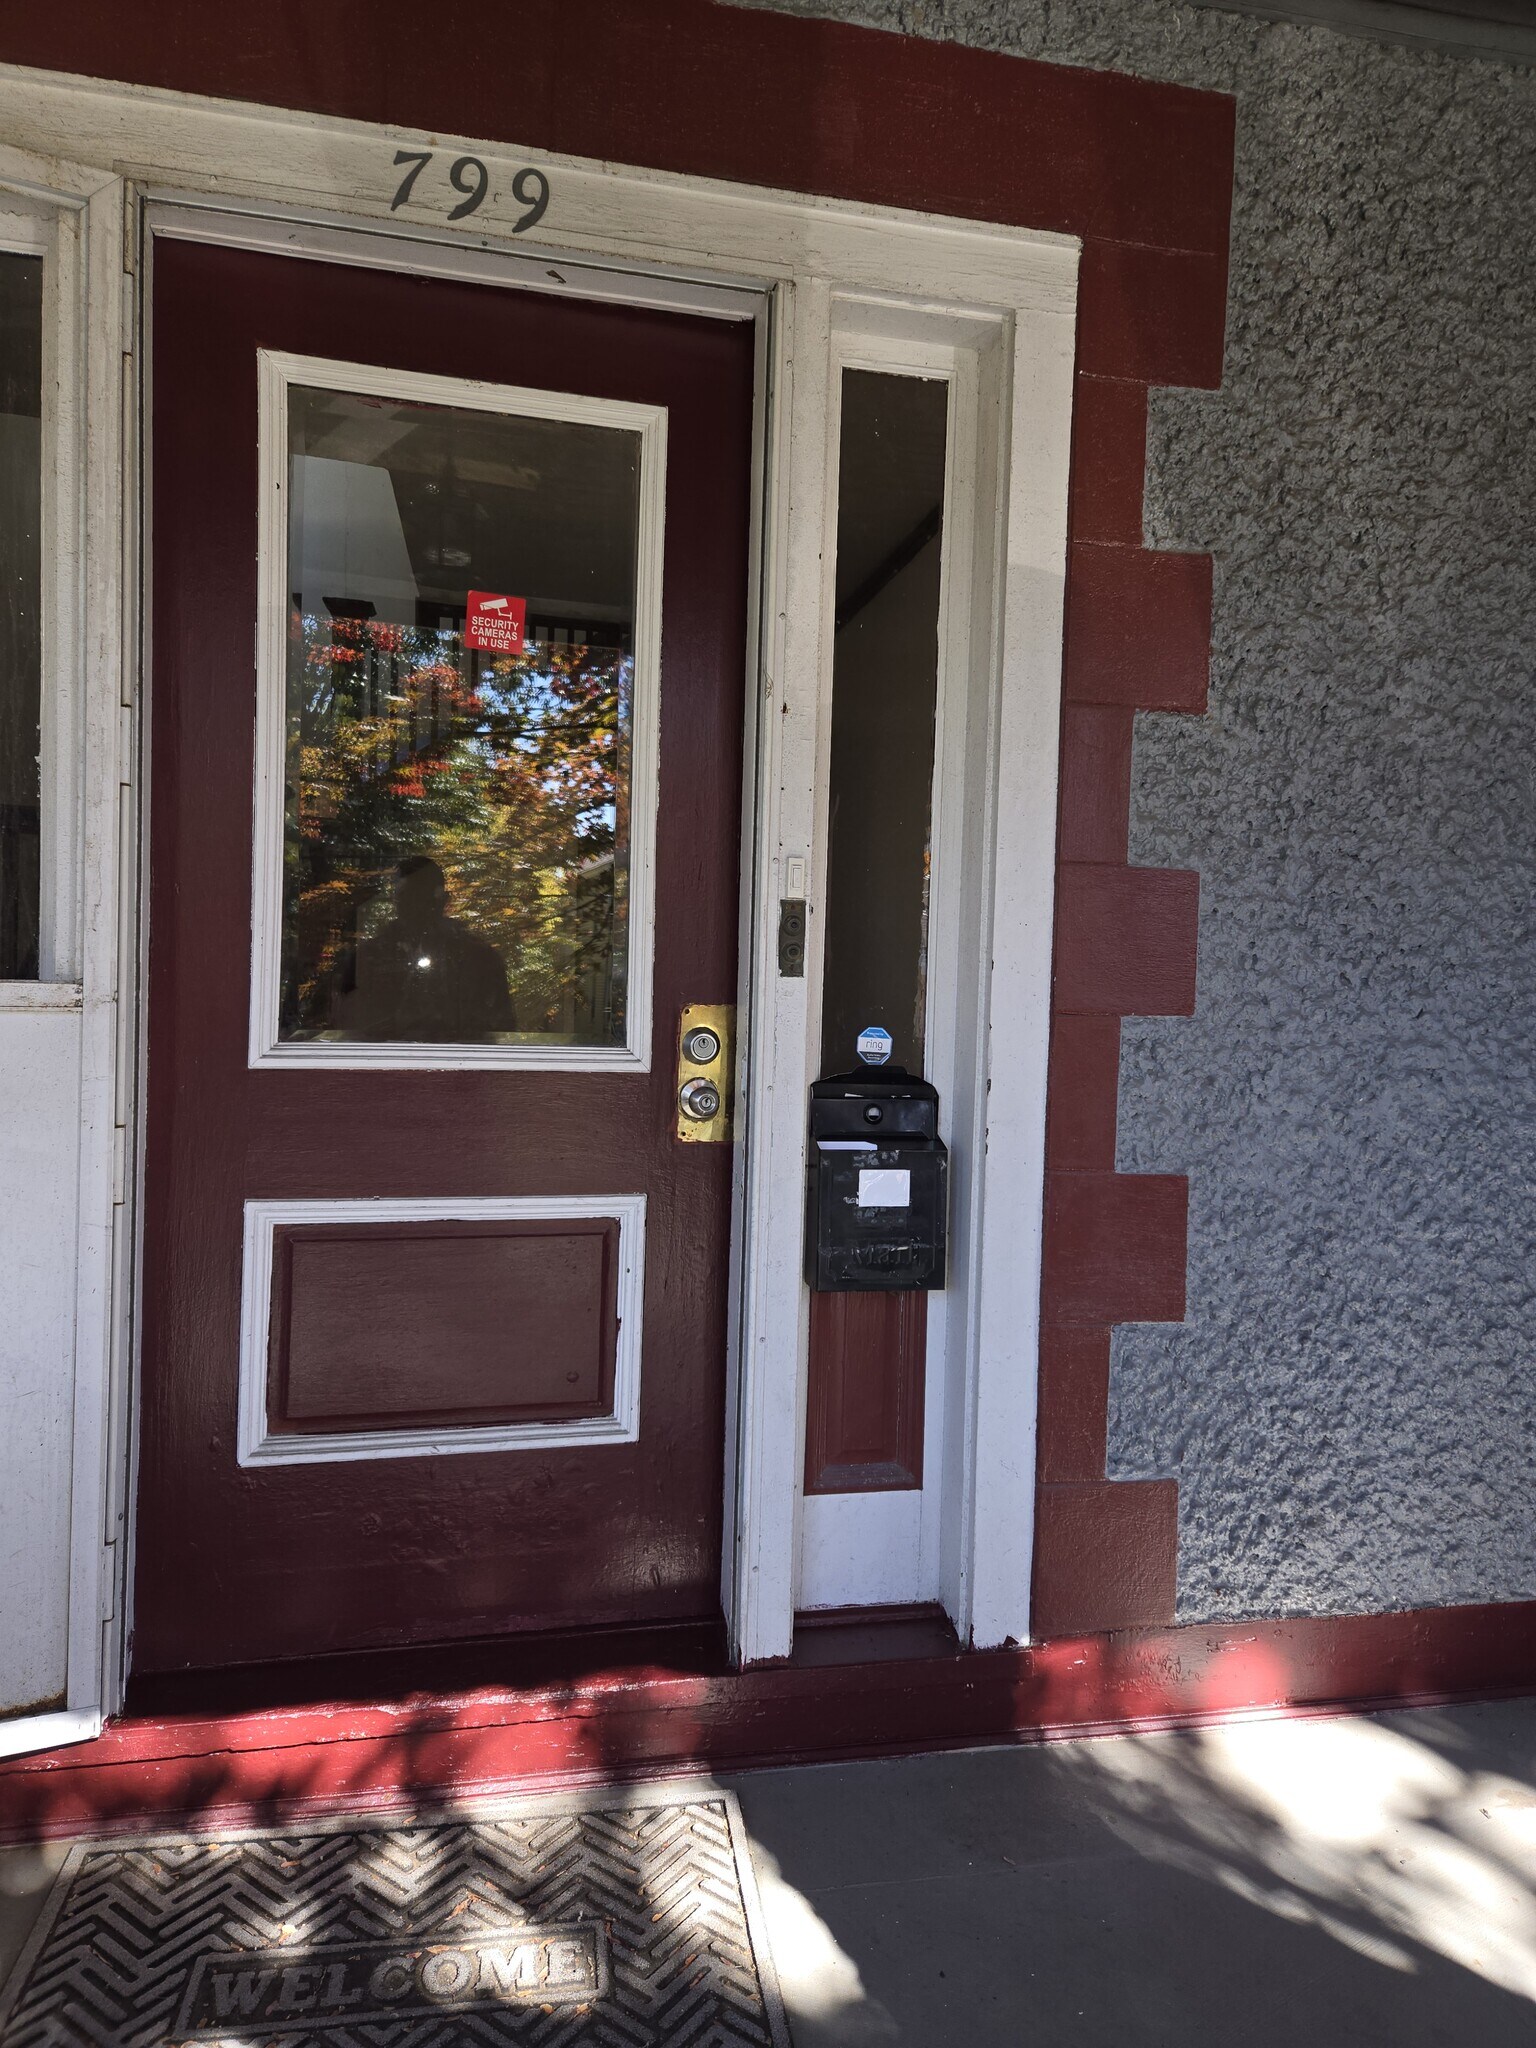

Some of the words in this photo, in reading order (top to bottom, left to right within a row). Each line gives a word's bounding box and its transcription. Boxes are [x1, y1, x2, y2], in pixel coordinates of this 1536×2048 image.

[390, 149, 550, 234] 799
[471, 616, 519, 631] SECURITY
[471, 626, 518, 641] CAMERAS
[478, 637, 488, 647] IN
[490, 638, 510, 650] USE
[865, 1039, 884, 1051] ring
[210, 1938, 586, 2016] WELCOME
